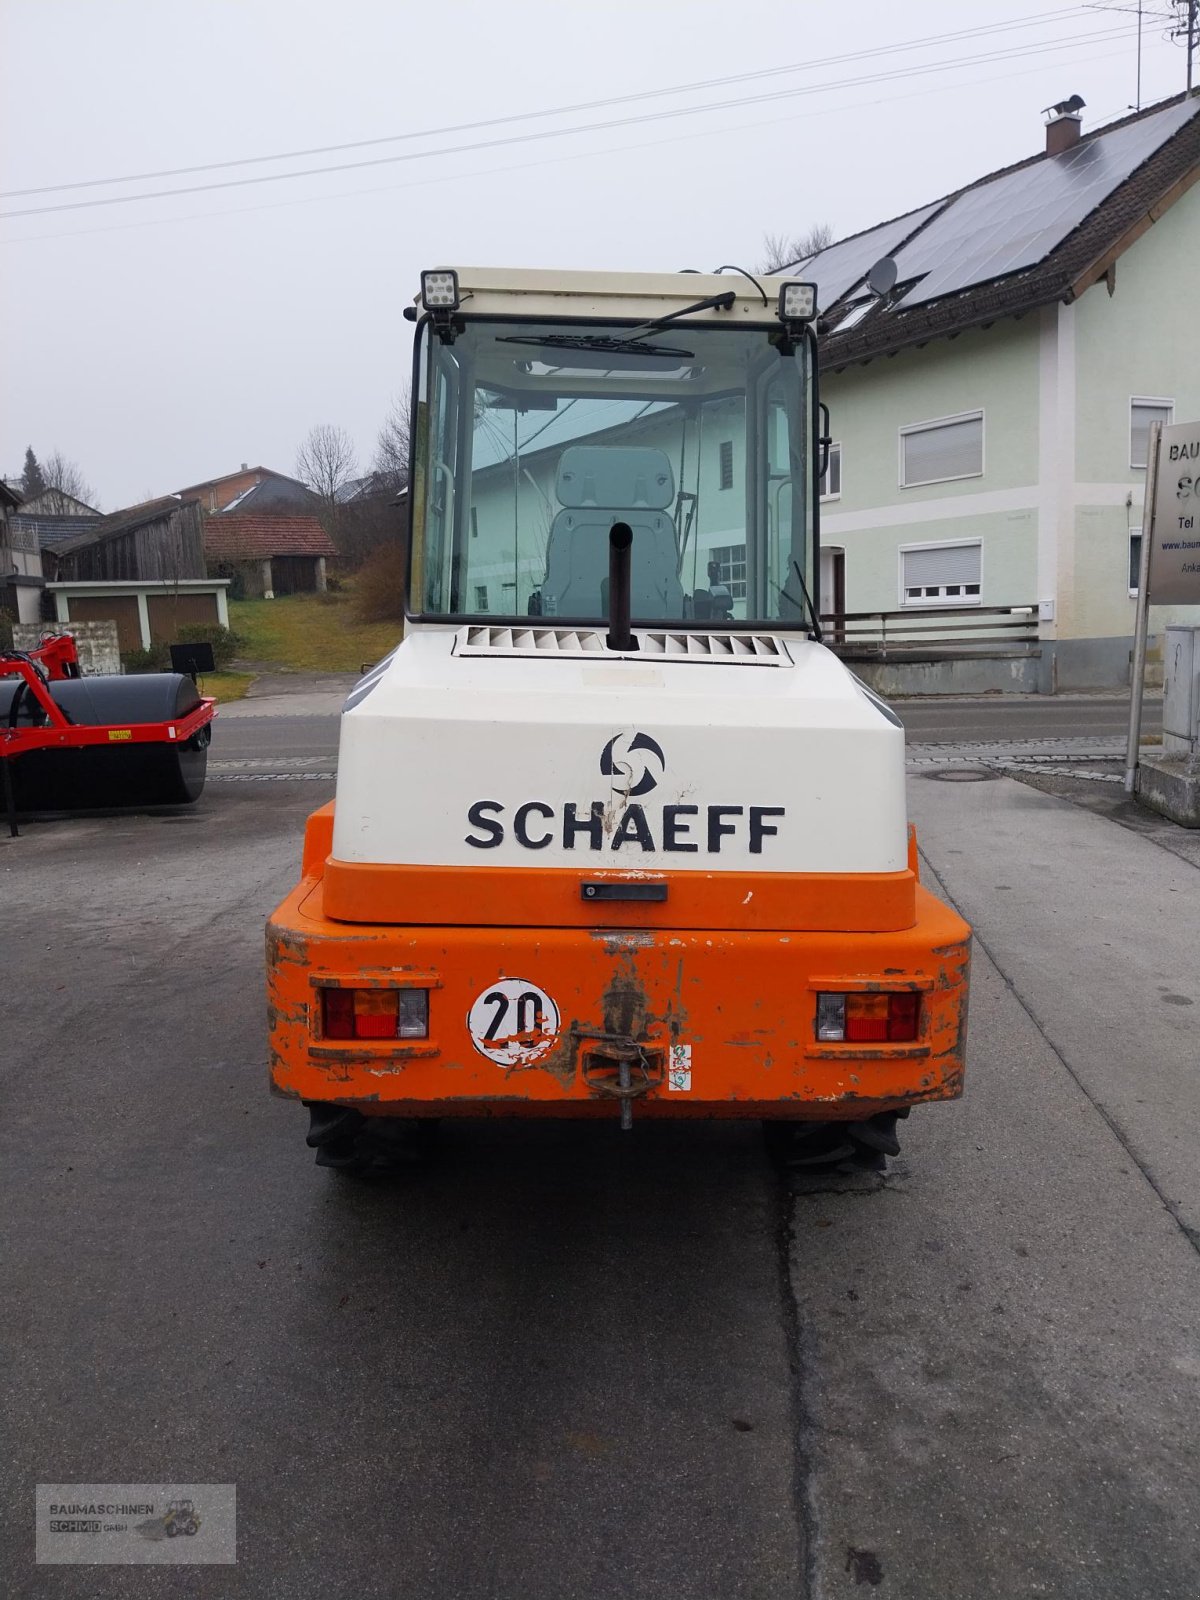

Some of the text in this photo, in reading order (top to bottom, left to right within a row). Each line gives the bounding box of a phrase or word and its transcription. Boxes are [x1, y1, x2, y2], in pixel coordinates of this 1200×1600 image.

[1178, 516, 1194, 529] Tel
[464, 800, 786, 854] SCHAEFF
[483, 991, 543, 1049] 20
